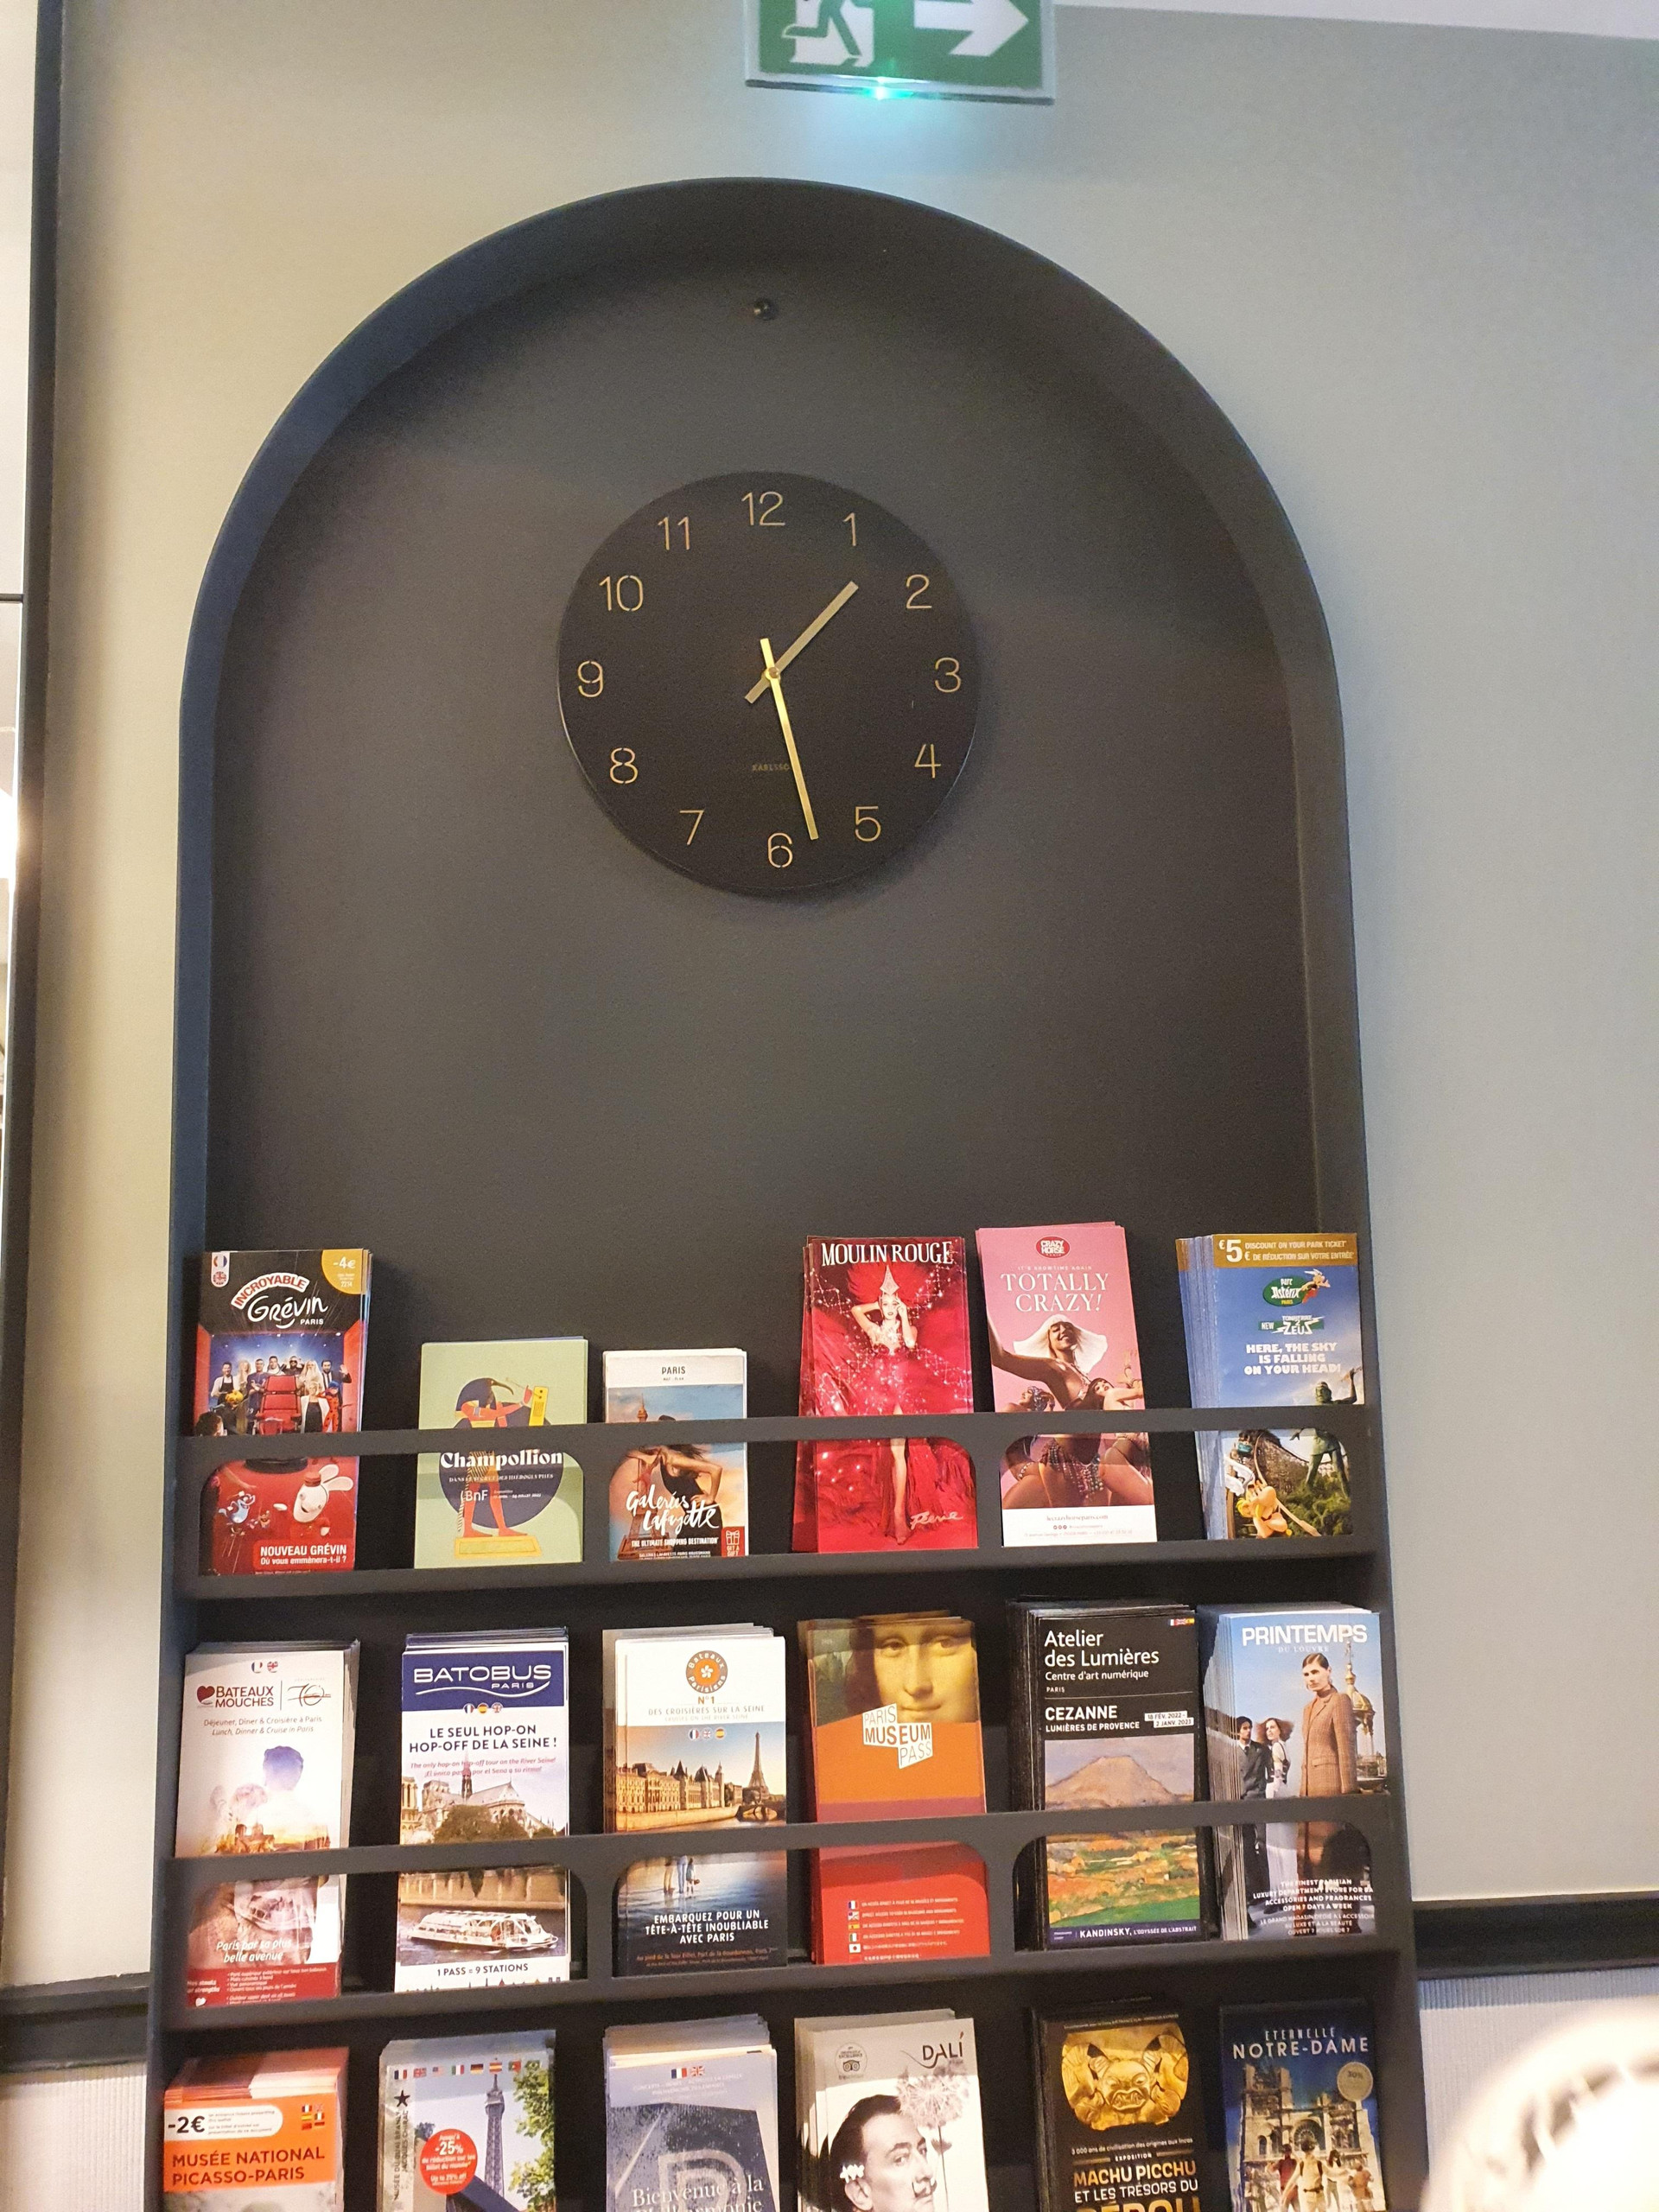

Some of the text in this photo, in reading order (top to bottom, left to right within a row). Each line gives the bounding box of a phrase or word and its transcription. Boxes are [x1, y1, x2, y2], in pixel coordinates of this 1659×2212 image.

[741, 491, 786, 526] 12
[658, 517, 691, 550] 11
[842, 512, 858, 547] 1
[598, 575, 645, 612] 10
[905, 574, 933, 610] 2
[576, 660, 605, 698] 9
[934, 657, 963, 693] 3
[608, 747, 639, 785] 8
[914, 744, 942, 779] 4
[679, 809, 705, 846] 7
[855, 805, 881, 842] 5
[767, 832, 794, 869] 6
[821, 1240, 953, 1267] MOULIN ROUGE
[233, 1274, 308, 1308] INCROYABLE
[1001, 1272, 1109, 1291] TOTALLY
[1015, 1294, 1103, 1313] CRAZY!
[1246, 1342, 1338, 1354] HERE, THE SKY
[1259, 1353, 1325, 1363] IS FALLING
[661, 1365, 686, 1375] PARIS
[1244, 1363, 1340, 1375] ON YOUR HEAD!
[440, 1449, 563, 1471] Champollion
[465, 1489, 488, 1502] BnF
[626, 1484, 690, 1516] Galeries
[642, 1498, 721, 1536] Lafayette
[260, 1542, 346, 1556] NOUVEAU GRÉVIN
[1044, 1630, 1103, 1647] Atelier
[1242, 1624, 1368, 1647] PRINTEMPS
[688, 1652, 725, 1669] Bateaux
[1044, 1648, 1160, 1667] des Lumières
[413, 1664, 551, 1683] BATOBUS
[1045, 1669, 1149, 1681] Centre d'art numérique
[216, 1686, 274, 1698] BATEAUX
[688, 1675, 726, 1693] Parisiens
[216, 1697, 274, 1708] MOUCHES
[665, 1706, 709, 1715] CROISIÈRES
[864, 1705, 896, 1725] PARIS
[1045, 1705, 1117, 1720] CEZANNE
[430, 1725, 537, 1738] LE SEUL HOP-ON
[865, 1724, 931, 1745] MUSEUM
[1046, 1720, 1140, 1732] LUMIÈRES DE PROVENCE
[410, 1738, 550, 1753] HOP-OFF DE LA SEINE
[899, 1740, 931, 1766] PASS
[437, 1760, 460, 1769] hop-on
[1253, 1891, 1277, 1899] LUXURY
[1279, 1888, 1325, 1897] DEPARTMENT
[1265, 1895, 1307, 1906] ACCESSORIES
[654, 1909, 760, 1924] EMBARQUEZ POUR UN
[645, 1919, 769, 1936] TÊTE-À-TÊTE INOUBLIABLE
[1080, 1927, 1132, 1939] KANDINSKY,
[217, 1939, 239, 1950] Paris
[679, 1932, 735, 1944] AVEC PARIS
[224, 1952, 283, 1963] belle avenue
[443, 1962, 529, 1976] PASS 9 STATIONS
[1265, 2027, 1335, 2042] ETERNELLE
[922, 2031, 964, 2063] DALÍ
[1233, 2037, 1369, 2060] NOTRE-DAME
[1107, 2142, 1135, 2152] civilisation
[1146, 2139, 1167, 2148] origines
[173, 2146, 325, 2168] MUSÉE NATIONAL
[1115, 2152, 1152, 2162] EXPOSITION
[173, 2166, 305, 2186] PICASSO-PARIS
[1073, 2160, 1197, 2188] MACHU PICCHU
[632, 2184, 726, 2208] Bienvenue
[731, 2177, 741, 2195] à
[747, 2174, 764, 2193] la
[1074, 2179, 1199, 2202] ET LES TRÉSORS DU
